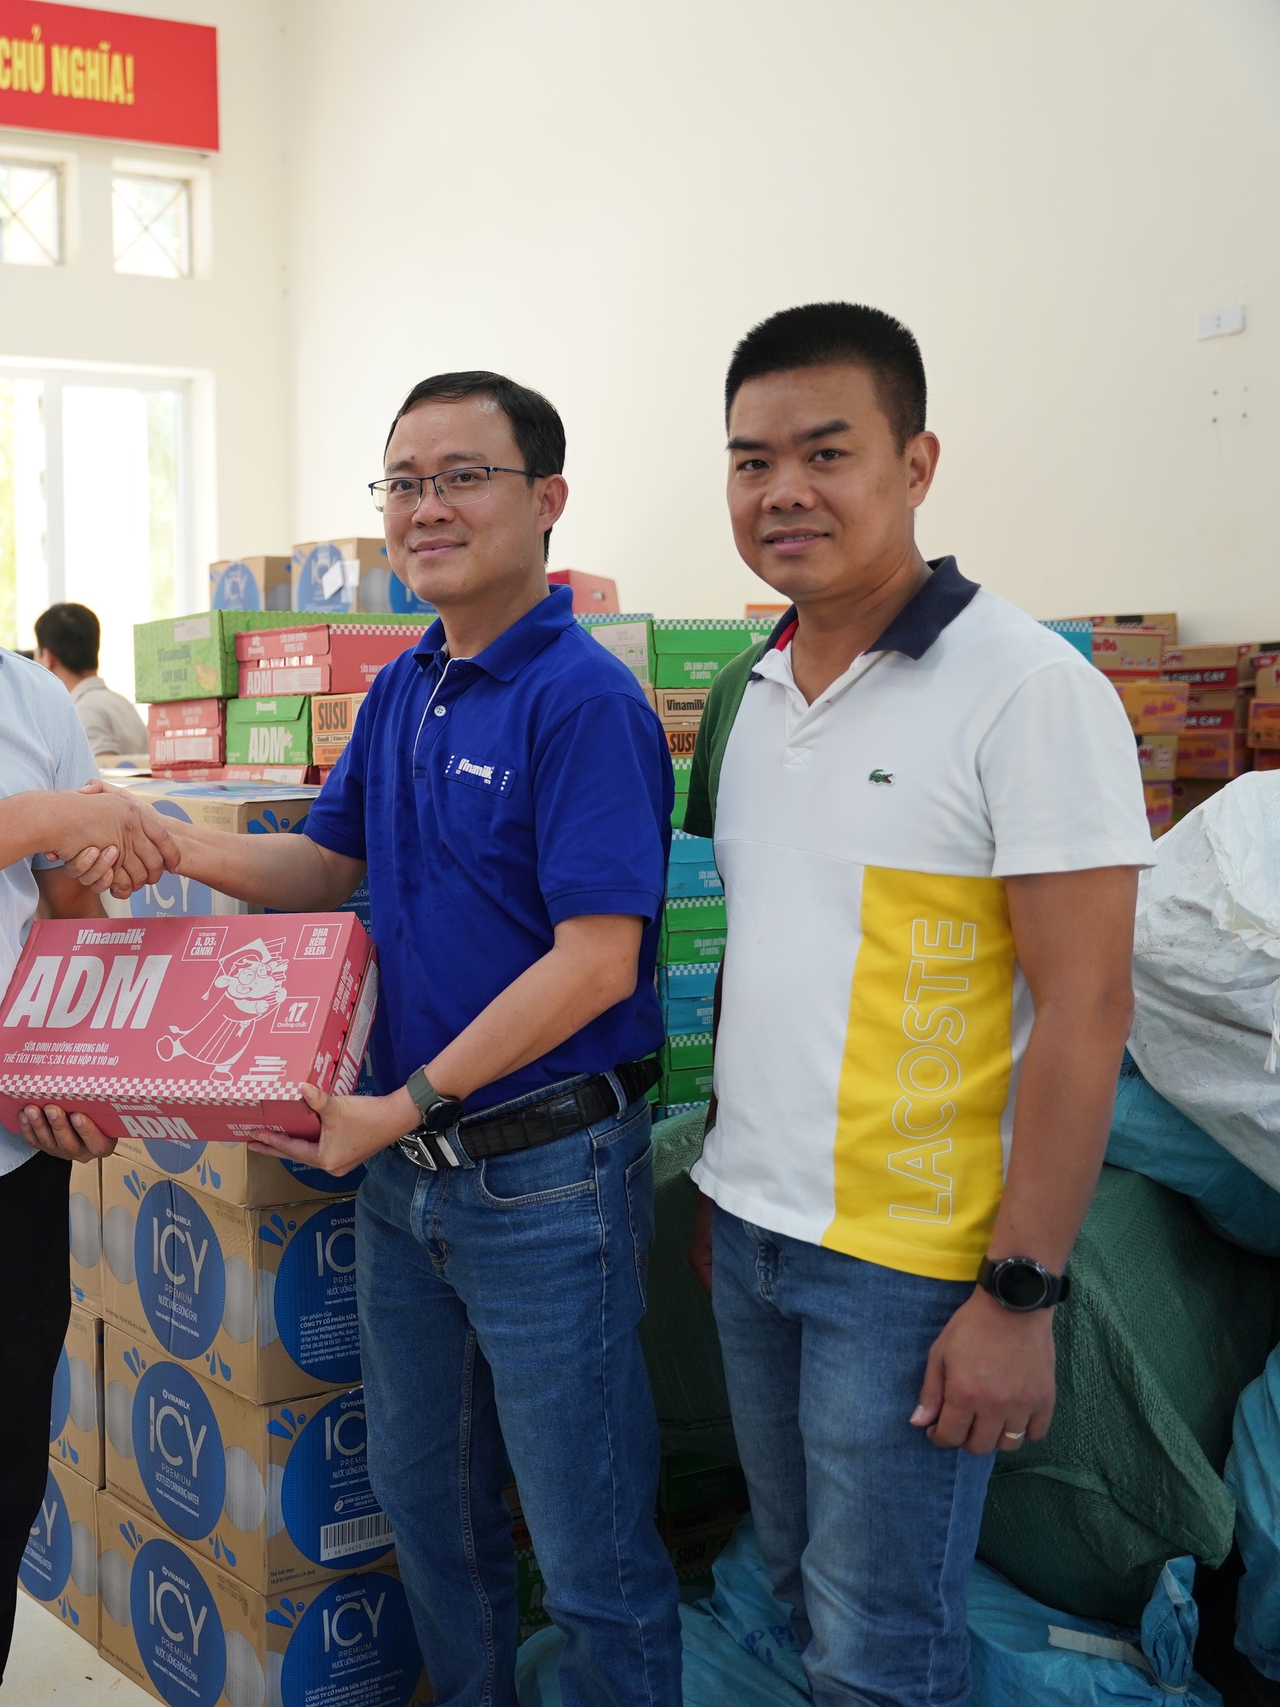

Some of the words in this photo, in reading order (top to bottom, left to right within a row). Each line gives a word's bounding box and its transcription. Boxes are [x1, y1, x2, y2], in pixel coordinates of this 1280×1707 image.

[51, 41, 135, 105] NGHĨA!
[246, 671, 271, 695] ADM
[317, 701, 348, 730] SUSU
[666, 699, 705, 711] Vinamilk
[155, 738, 174, 761] ADM
[247, 726, 286, 763] ADM
[458, 758, 493, 780] Vinamilk
[76, 929, 144, 945] Vinamilk
[194, 937, 203, 948] A,
[312, 928, 328, 937] DHA
[304, 946, 327, 956] SELEN
[2, 954, 174, 1030] ADM
[288, 1002, 309, 1022] 17
[23, 1040, 37, 1052] SỮA
[36, 1042, 52, 1052] DINH
[51, 1041, 73, 1053] DƯỠNG
[72, 1042, 96, 1053] HƯƠNG
[95, 1042, 110, 1053] DÂU
[16, 1053, 30, 1064] TÍCH
[47, 1054, 62, 1066] 5,28
[61, 1054, 66, 1065] L
[66, 1054, 77, 1066] (48
[76, 1053, 91, 1067] HỘP
[96, 1055, 107, 1066] 110
[332, 1054, 357, 1096] DM
[887, 918, 977, 1225] LACOSTE
[118, 1115, 199, 1140] ADM
[336, 1216, 356, 1225] VINAM
[152, 1216, 209, 1295] ICY
[315, 1227, 357, 1277] IC
[333, 1275, 355, 1285] PREM
[164, 1283, 193, 1305] PREMIUM
[300, 1321, 315, 1329] CÔNG
[167, 1391, 191, 1411] VINAMILK
[346, 1399, 366, 1408] VINAM
[149, 1395, 208, 1478] ICY
[325, 1410, 366, 1461] IC
[340, 1457, 368, 1467] PREMI
[359, 1463, 368, 1473] ĐÓN
[161, 1462, 192, 1487] PREMIUM
[166, 1571, 191, 1591] VINAMILK
[341, 1588, 367, 1600] VINAMILK
[148, 1569, 208, 1657] ICY
[322, 1591, 386, 1653] ICY
[161, 1636, 192, 1664] PREMIUM
[338, 1642, 372, 1658] PREMIUM
